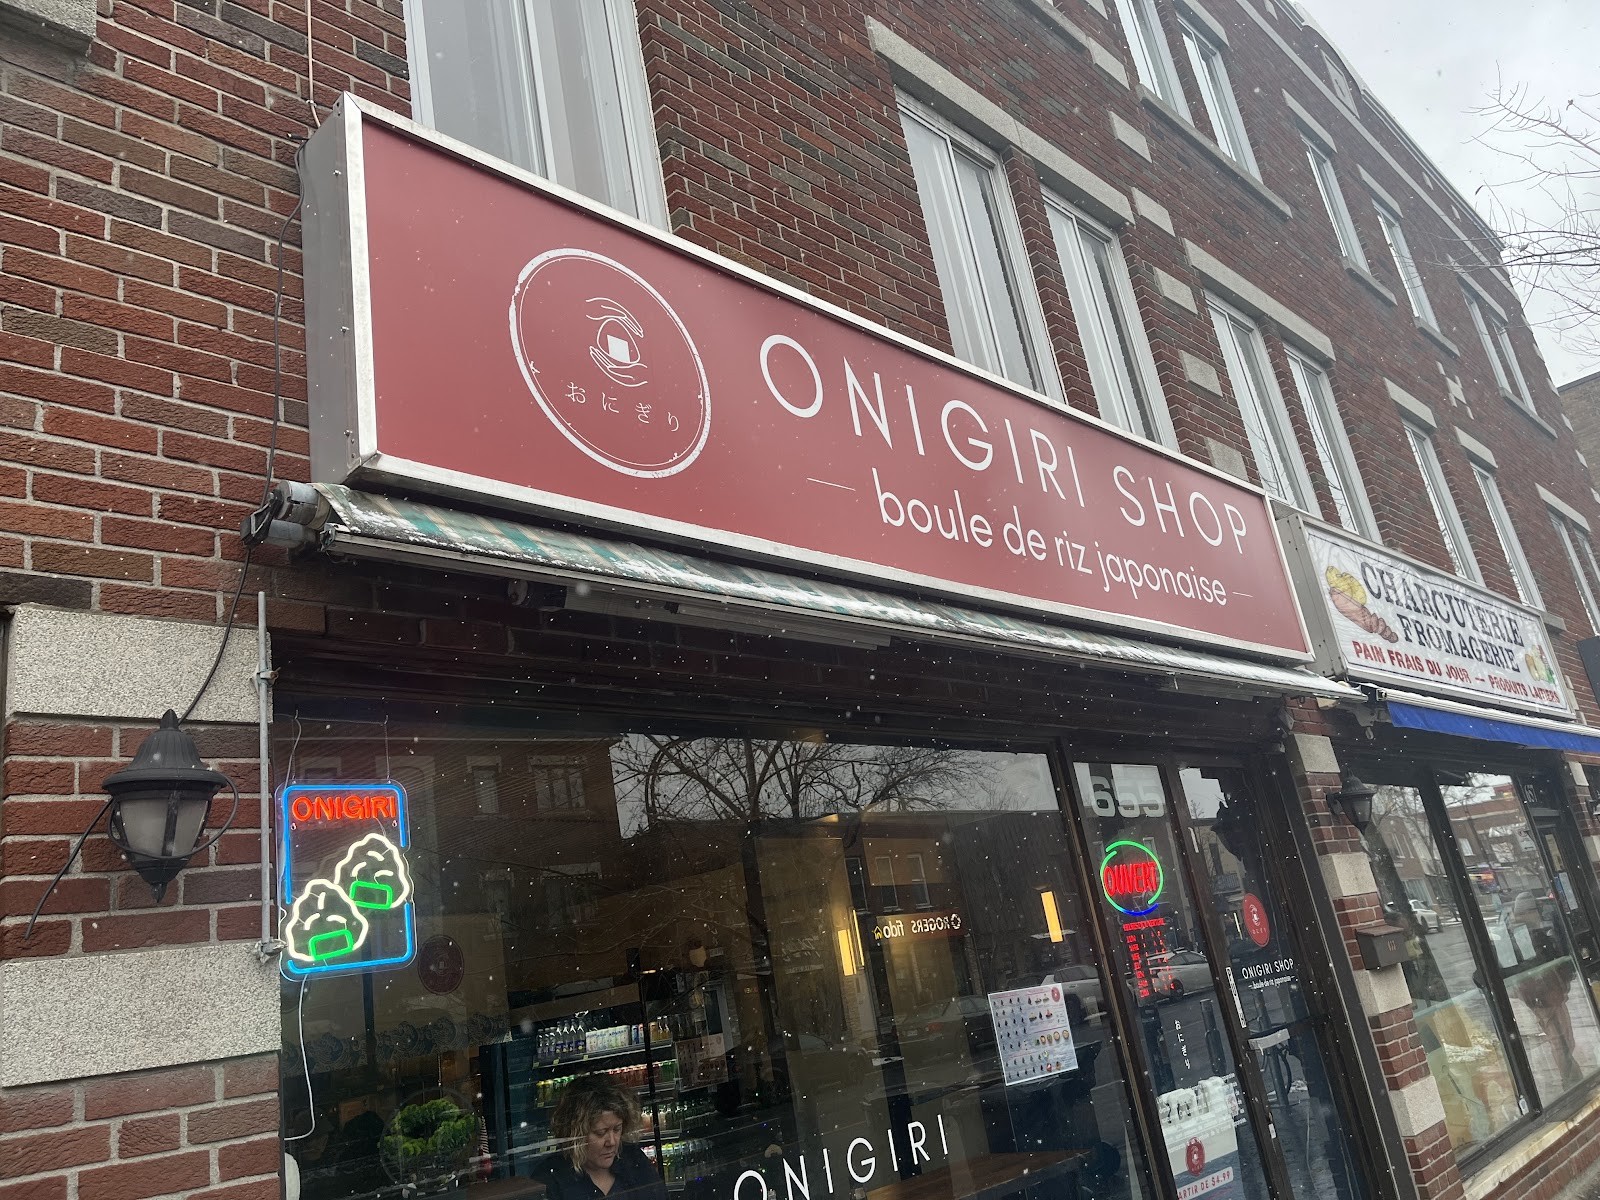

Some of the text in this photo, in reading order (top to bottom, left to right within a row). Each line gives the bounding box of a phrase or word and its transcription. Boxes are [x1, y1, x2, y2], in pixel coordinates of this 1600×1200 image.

[565, 381, 679, 431] おにぎり
[760, 334, 1248, 555] ONIGIRI SHOP
[872, 468, 1227, 606] boule de riz japonaise
[1361, 562, 1524, 647] CHARCUTERIE
[1352, 640, 1386, 664] PAIN
[1387, 649, 1425, 672] FRAIS
[1425, 658, 1443, 676] DU
[1445, 664, 1472, 684] JOUR
[1488, 674, 1528, 697] PRODUITS
[1397, 613, 1520, 673] FROMAGERIE
[292, 795, 397, 821] ONIGIRI
[1087, 775, 1165, 818] 655
[1103, 861, 1157, 897] OUVERT
[1242, 958, 1294, 979] ONIGIRI SHOP
[733, 1114, 948, 1200] ONIGIRI
[1178, 1171, 1231, 1200] ARTIR DE $4.99
